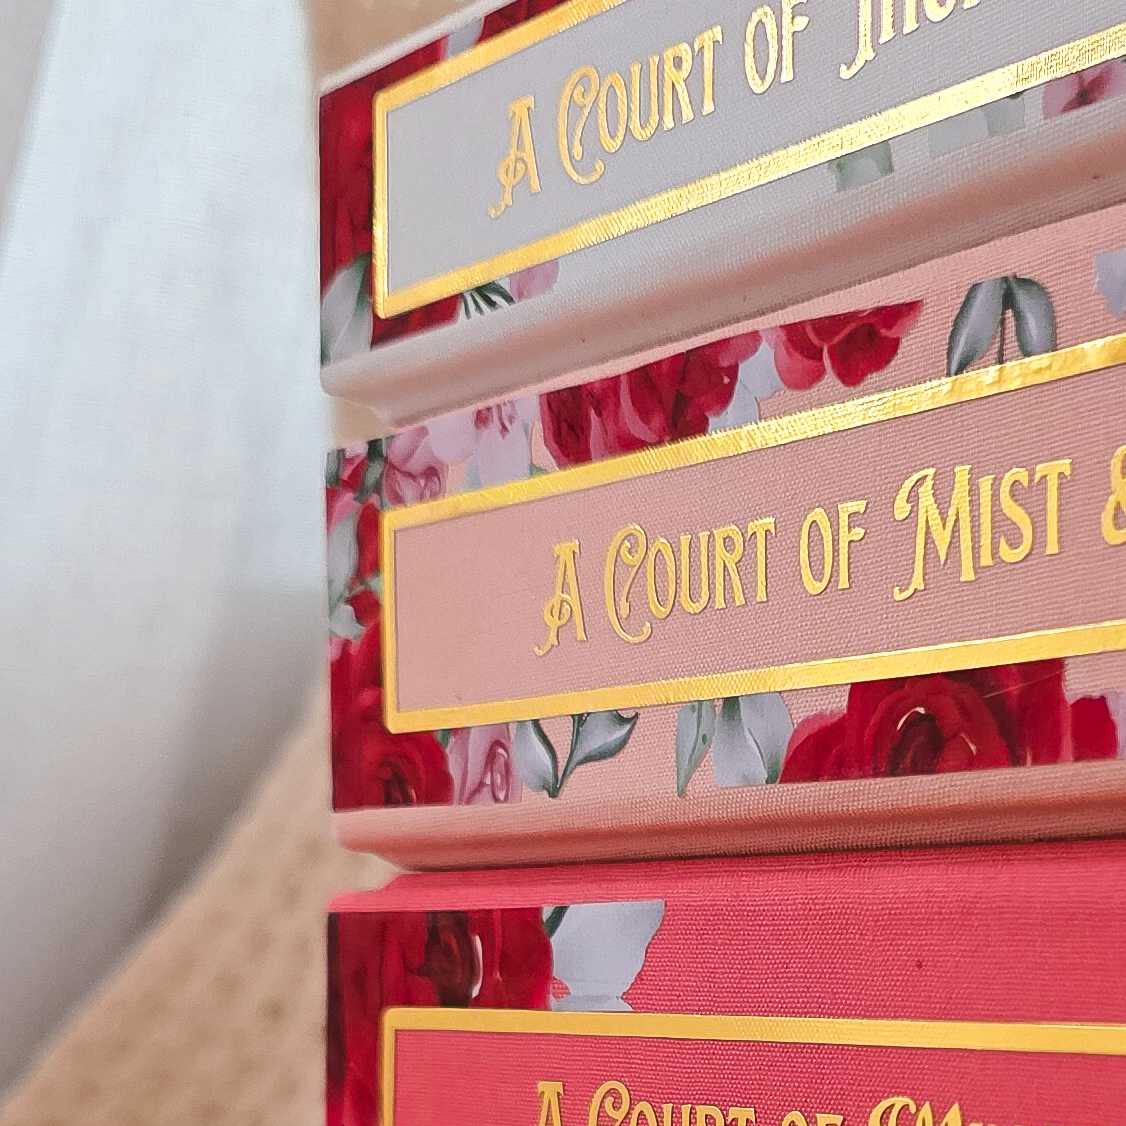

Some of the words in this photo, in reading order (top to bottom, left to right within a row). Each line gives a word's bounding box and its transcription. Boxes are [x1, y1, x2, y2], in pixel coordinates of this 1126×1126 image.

[488, 96, 541, 217] A
[556, 27, 723, 184] COURT
[743, 0, 809, 94] OF
[534, 540, 585, 655] A
[605, 518, 777, 643] COURT
[800, 500, 867, 594] OF
[892, 459, 1073, 601] MIST
